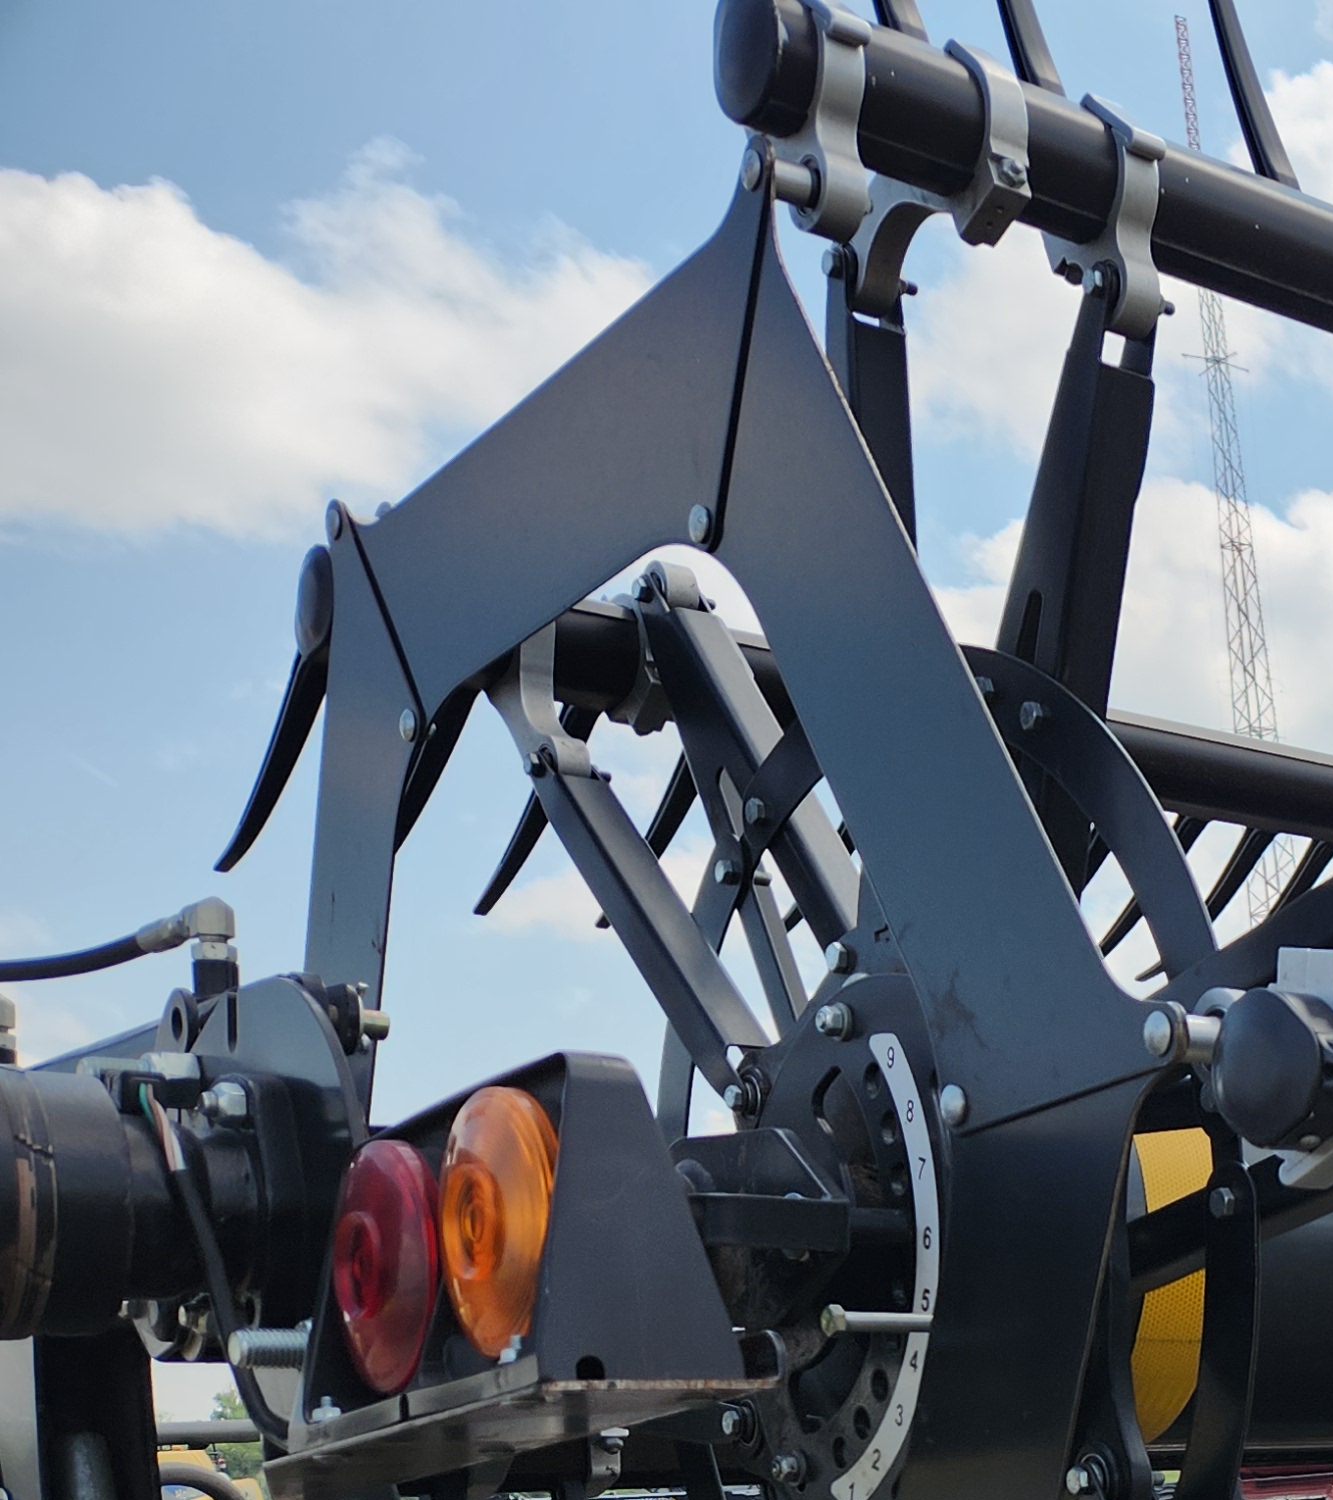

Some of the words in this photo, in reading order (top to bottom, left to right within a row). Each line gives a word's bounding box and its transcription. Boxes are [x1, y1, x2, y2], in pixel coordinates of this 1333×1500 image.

[886, 1045, 895, 1069] 9
[906, 1099, 915, 1123] 8
[917, 1156, 927, 1180] 7
[922, 1225, 932, 1250] 6
[920, 1288, 931, 1312] 5
[909, 1350, 919, 1373] 4
[894, 1403, 904, 1427] 3
[871, 1448, 882, 1471] 2
